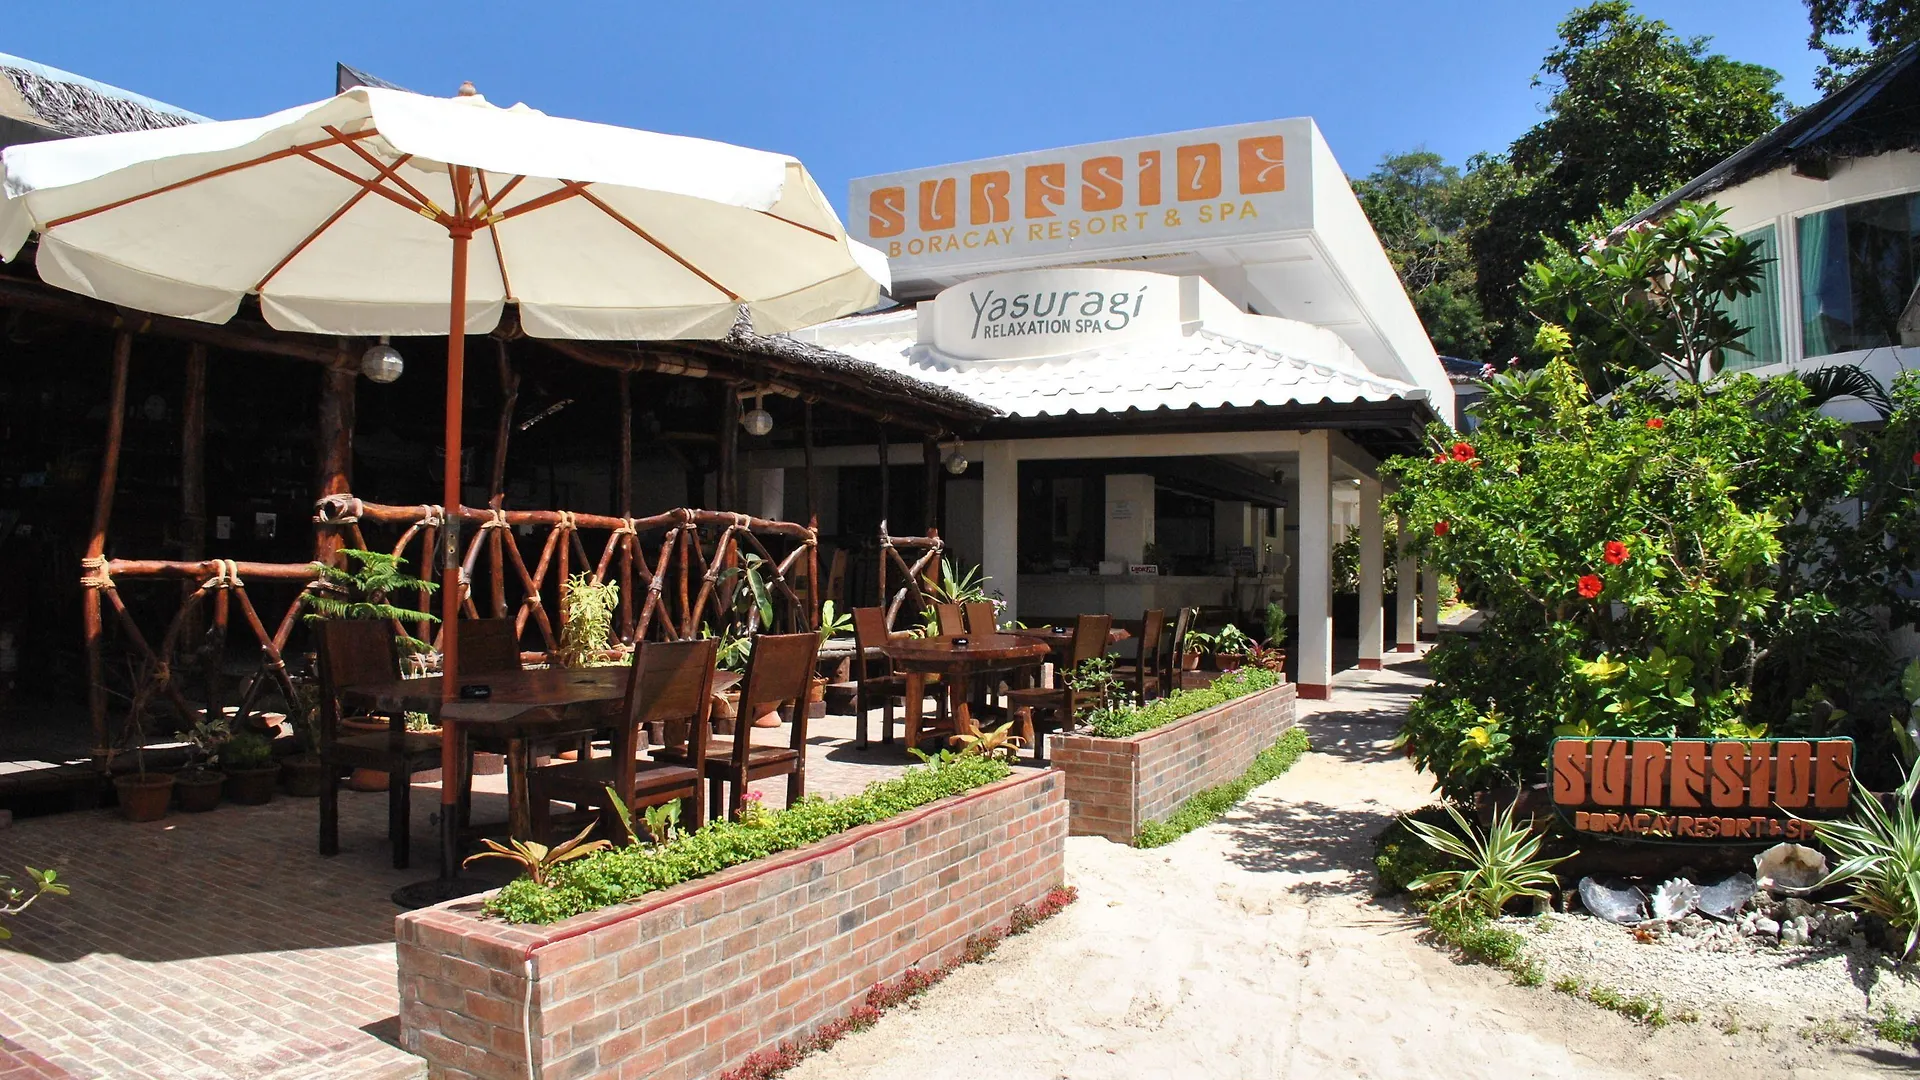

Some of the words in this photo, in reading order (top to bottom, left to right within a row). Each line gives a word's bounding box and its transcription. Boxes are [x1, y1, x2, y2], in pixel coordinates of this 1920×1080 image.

[869, 135, 1285, 239] SURFSIDE
[889, 226, 1015, 258] BORACAY
[1029, 212, 1147, 241] RESORT
[1163, 208, 1181, 228] &
[1199, 200, 1258, 221] SPA
[969, 285, 1148, 339] Yasuragi
[984, 319, 1071, 339] RELAXATION
[1075, 318, 1102, 334] SPA
[1553, 740, 1853, 808] SURFSIDE
[1575, 811, 1676, 836] BORACAY
[1677, 815, 1766, 838] RESORT
[1769, 818, 1781, 836] &
[1785, 818, 1818, 841] SP
